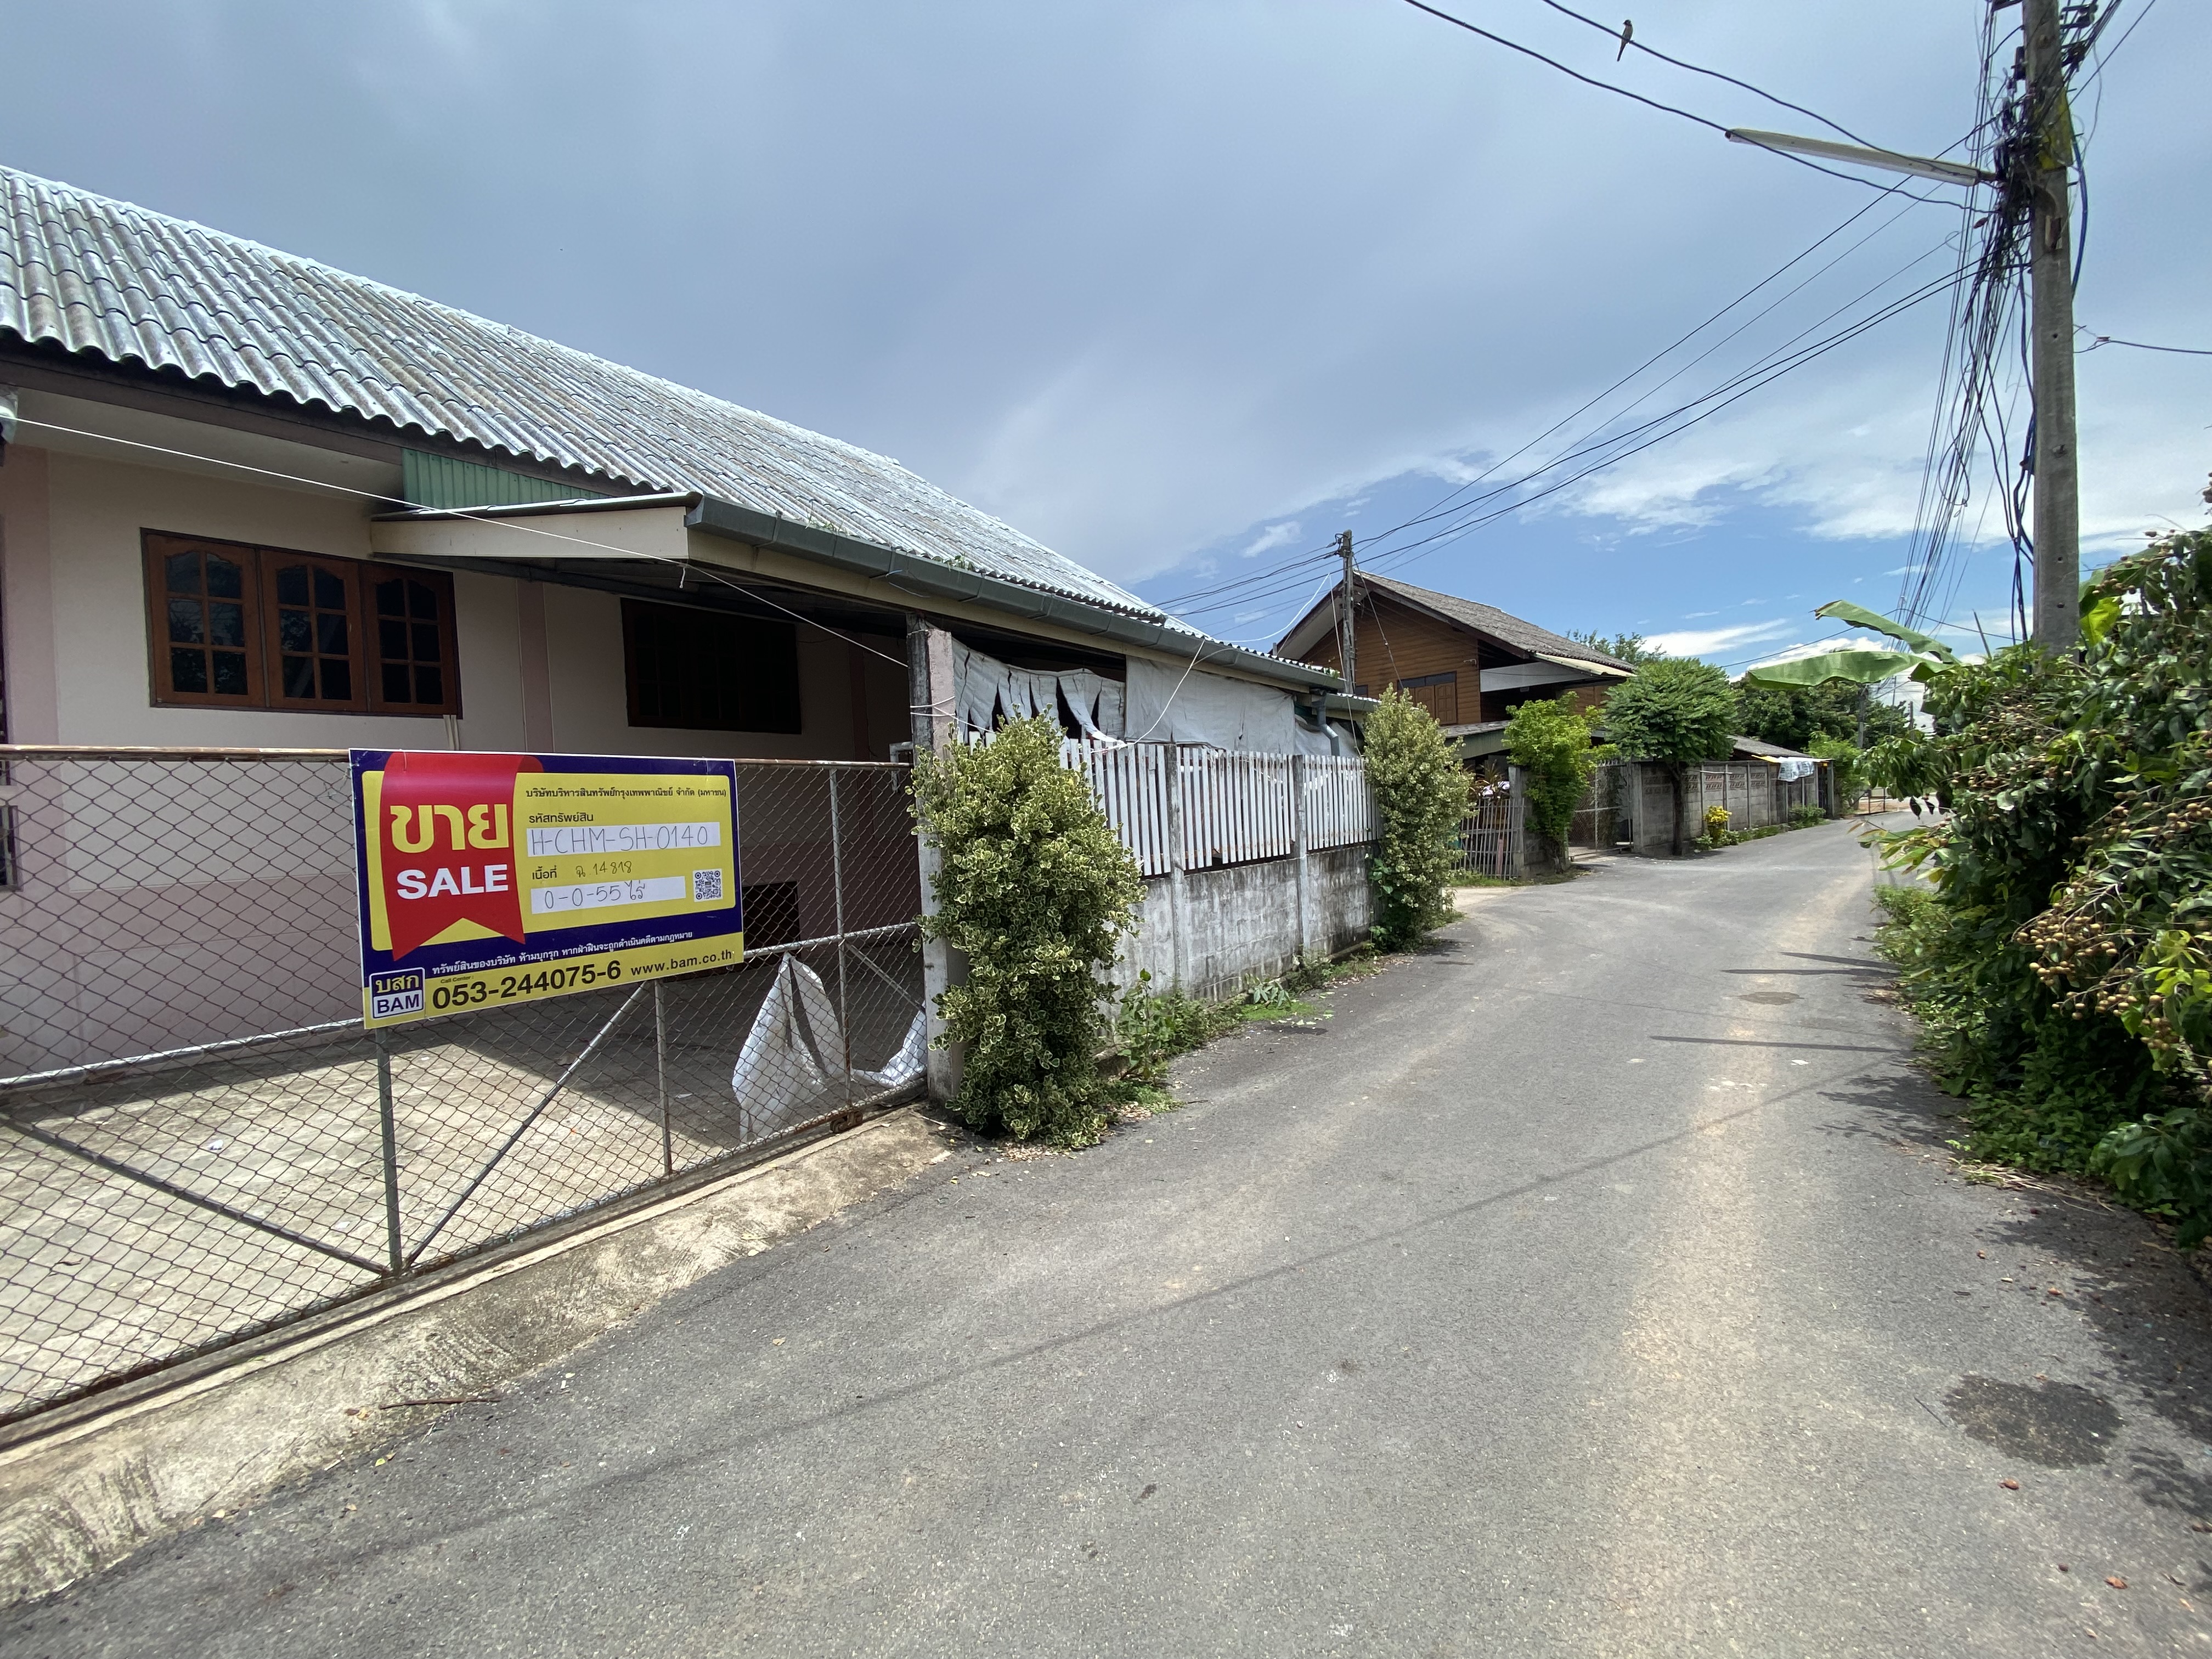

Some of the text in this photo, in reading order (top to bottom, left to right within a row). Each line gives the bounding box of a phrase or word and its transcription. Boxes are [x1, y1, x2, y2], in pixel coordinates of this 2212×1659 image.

[526, 786, 726, 800] บริษัทบริหารสินทรัพย์กรุงเทพพาณิชย์ จำกัด (มหาชน)
[529, 811, 594, 823] รหัสทรัพย์สิน
[390, 804, 509, 853] ขาย
[397, 864, 508, 899] SALE
[532, 865, 557, 880] เนื้อที่
[432, 955, 516, 975] ทรัพย์สินของบริษัท
[518, 950, 558, 962] ห้ามบุกรุก
[375, 975, 419, 993] บสก
[432, 950, 732, 1009] 053-244075-6 www.bam.co.th
[377, 994, 419, 1014] BAM
